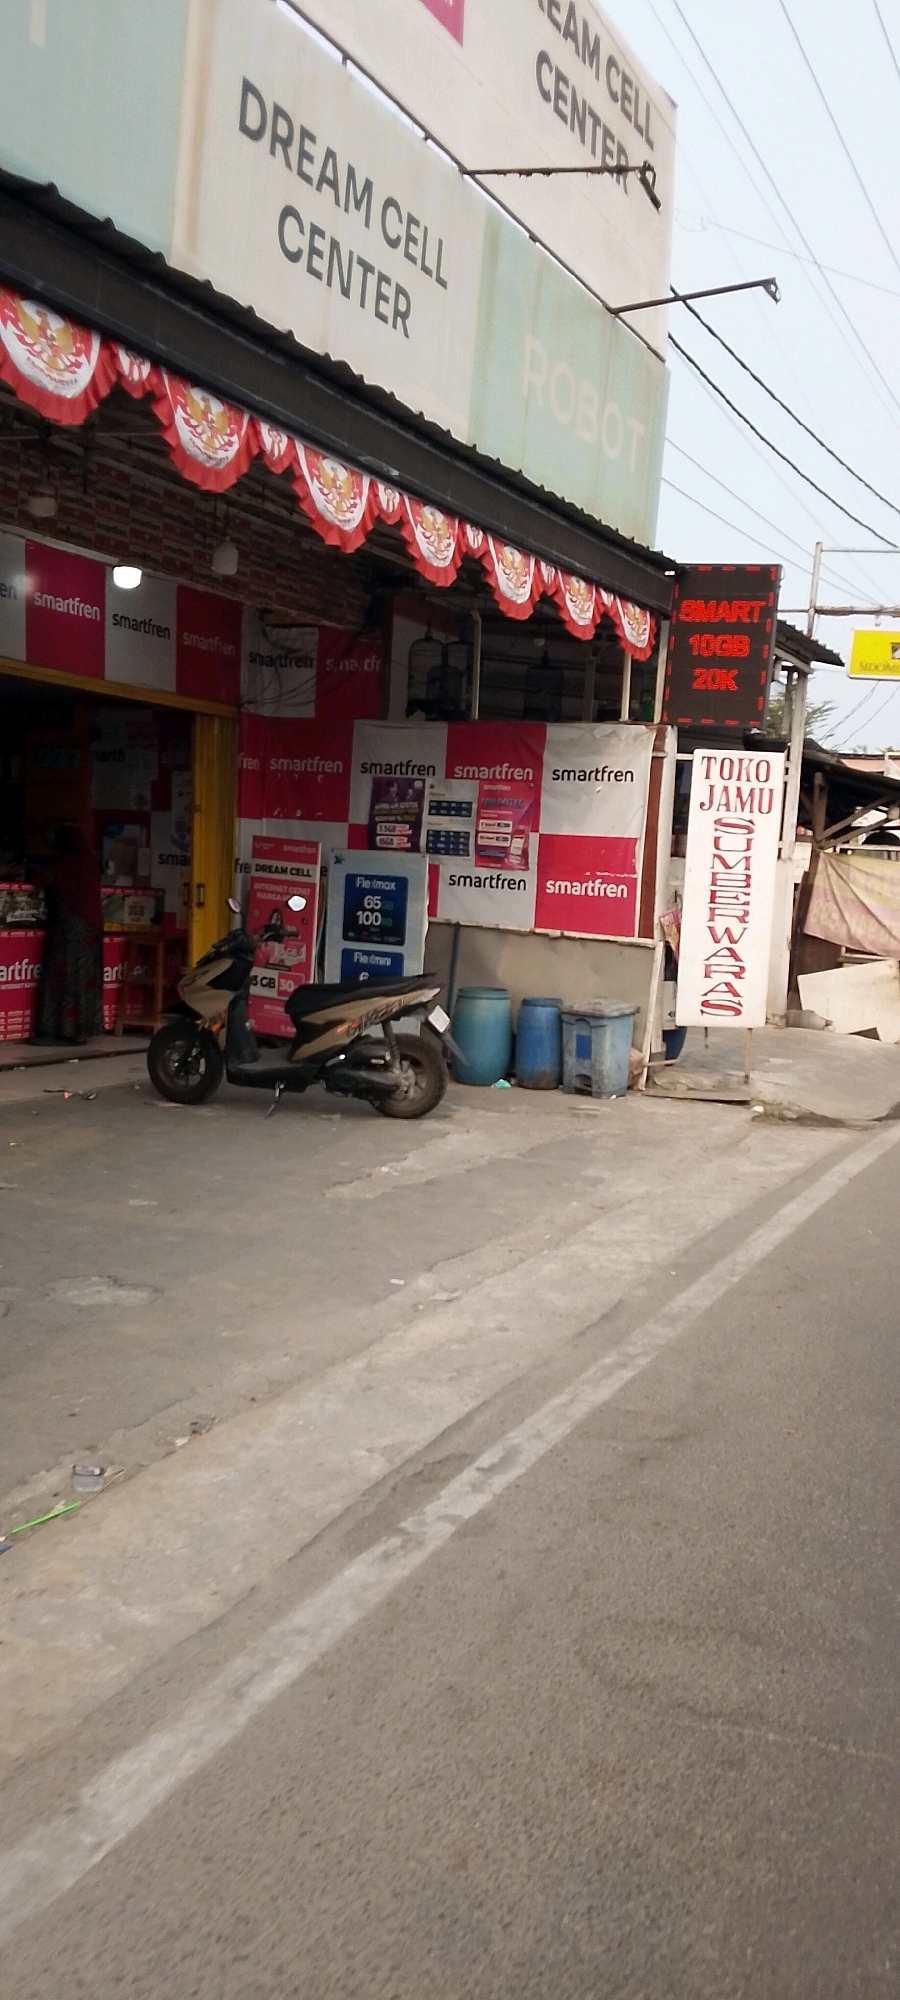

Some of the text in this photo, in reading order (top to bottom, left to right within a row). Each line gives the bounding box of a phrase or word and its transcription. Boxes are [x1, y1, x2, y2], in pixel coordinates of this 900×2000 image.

[605, 54, 655, 152] CELL
[535, 49, 629, 196] CENTER
[238, 76, 449, 290] DREAM CELL
[277, 204, 412, 339] CENTER
[521, 334, 646, 474] ROBOT
[33, 590, 101, 621] smartfren
[679, 599, 766, 624] SMART
[112, 612, 171, 641] smartfren
[182, 631, 236, 656] smartfren
[689, 634, 750, 657] 10GB
[249, 652, 314, 669] smartfren
[692, 667, 738, 691] 20K
[270, 756, 343, 774] smartfren
[360, 760, 436, 777] smartfren
[454, 763, 533, 781] smartfren
[552, 766, 634, 783] smartfren
[701, 755, 771, 783] TOKO
[700, 785, 775, 815] JAMU
[255, 863, 288, 875] DREAM
[290, 868, 312, 877] CELL
[449, 874, 527, 891] smartfren
[546, 879, 628, 898] smartfren
[700, 817, 756, 1018] SUMBERWARAS
[260, 977, 276, 989] GB
